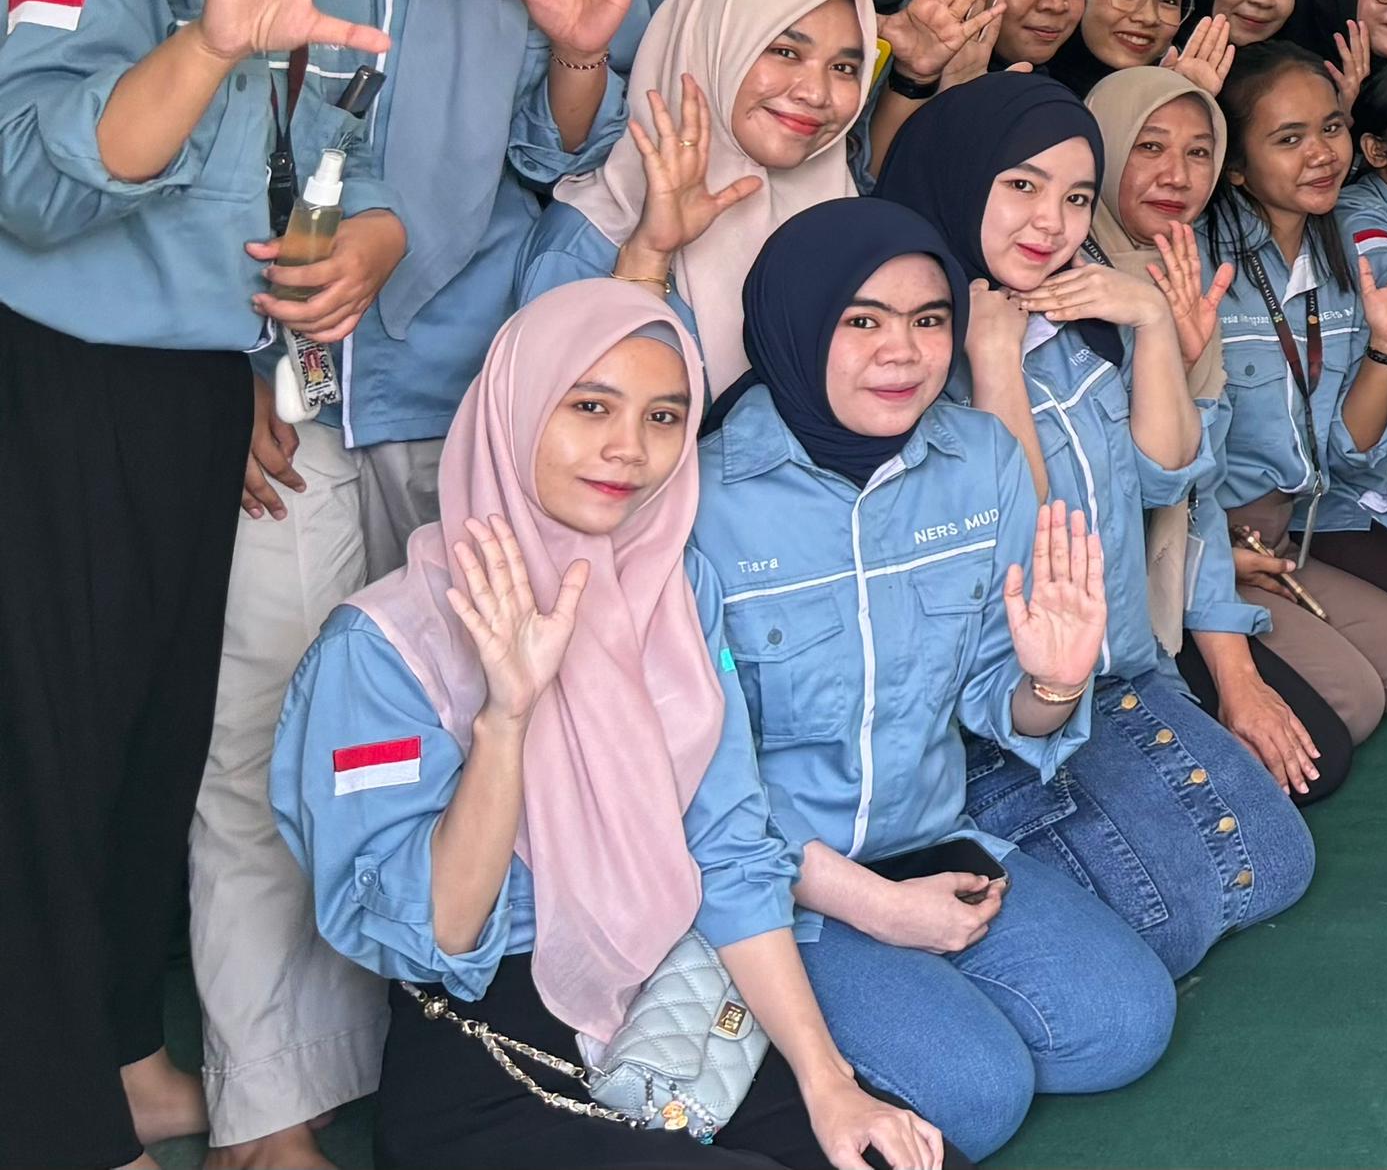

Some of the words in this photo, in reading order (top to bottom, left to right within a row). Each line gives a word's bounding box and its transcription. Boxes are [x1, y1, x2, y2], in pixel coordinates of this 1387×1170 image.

[1068, 348, 1091, 367] NER
[913, 521, 959, 545] NERS
[964, 508, 1000, 532] MUD
[737, 557, 780, 574] Tiara
